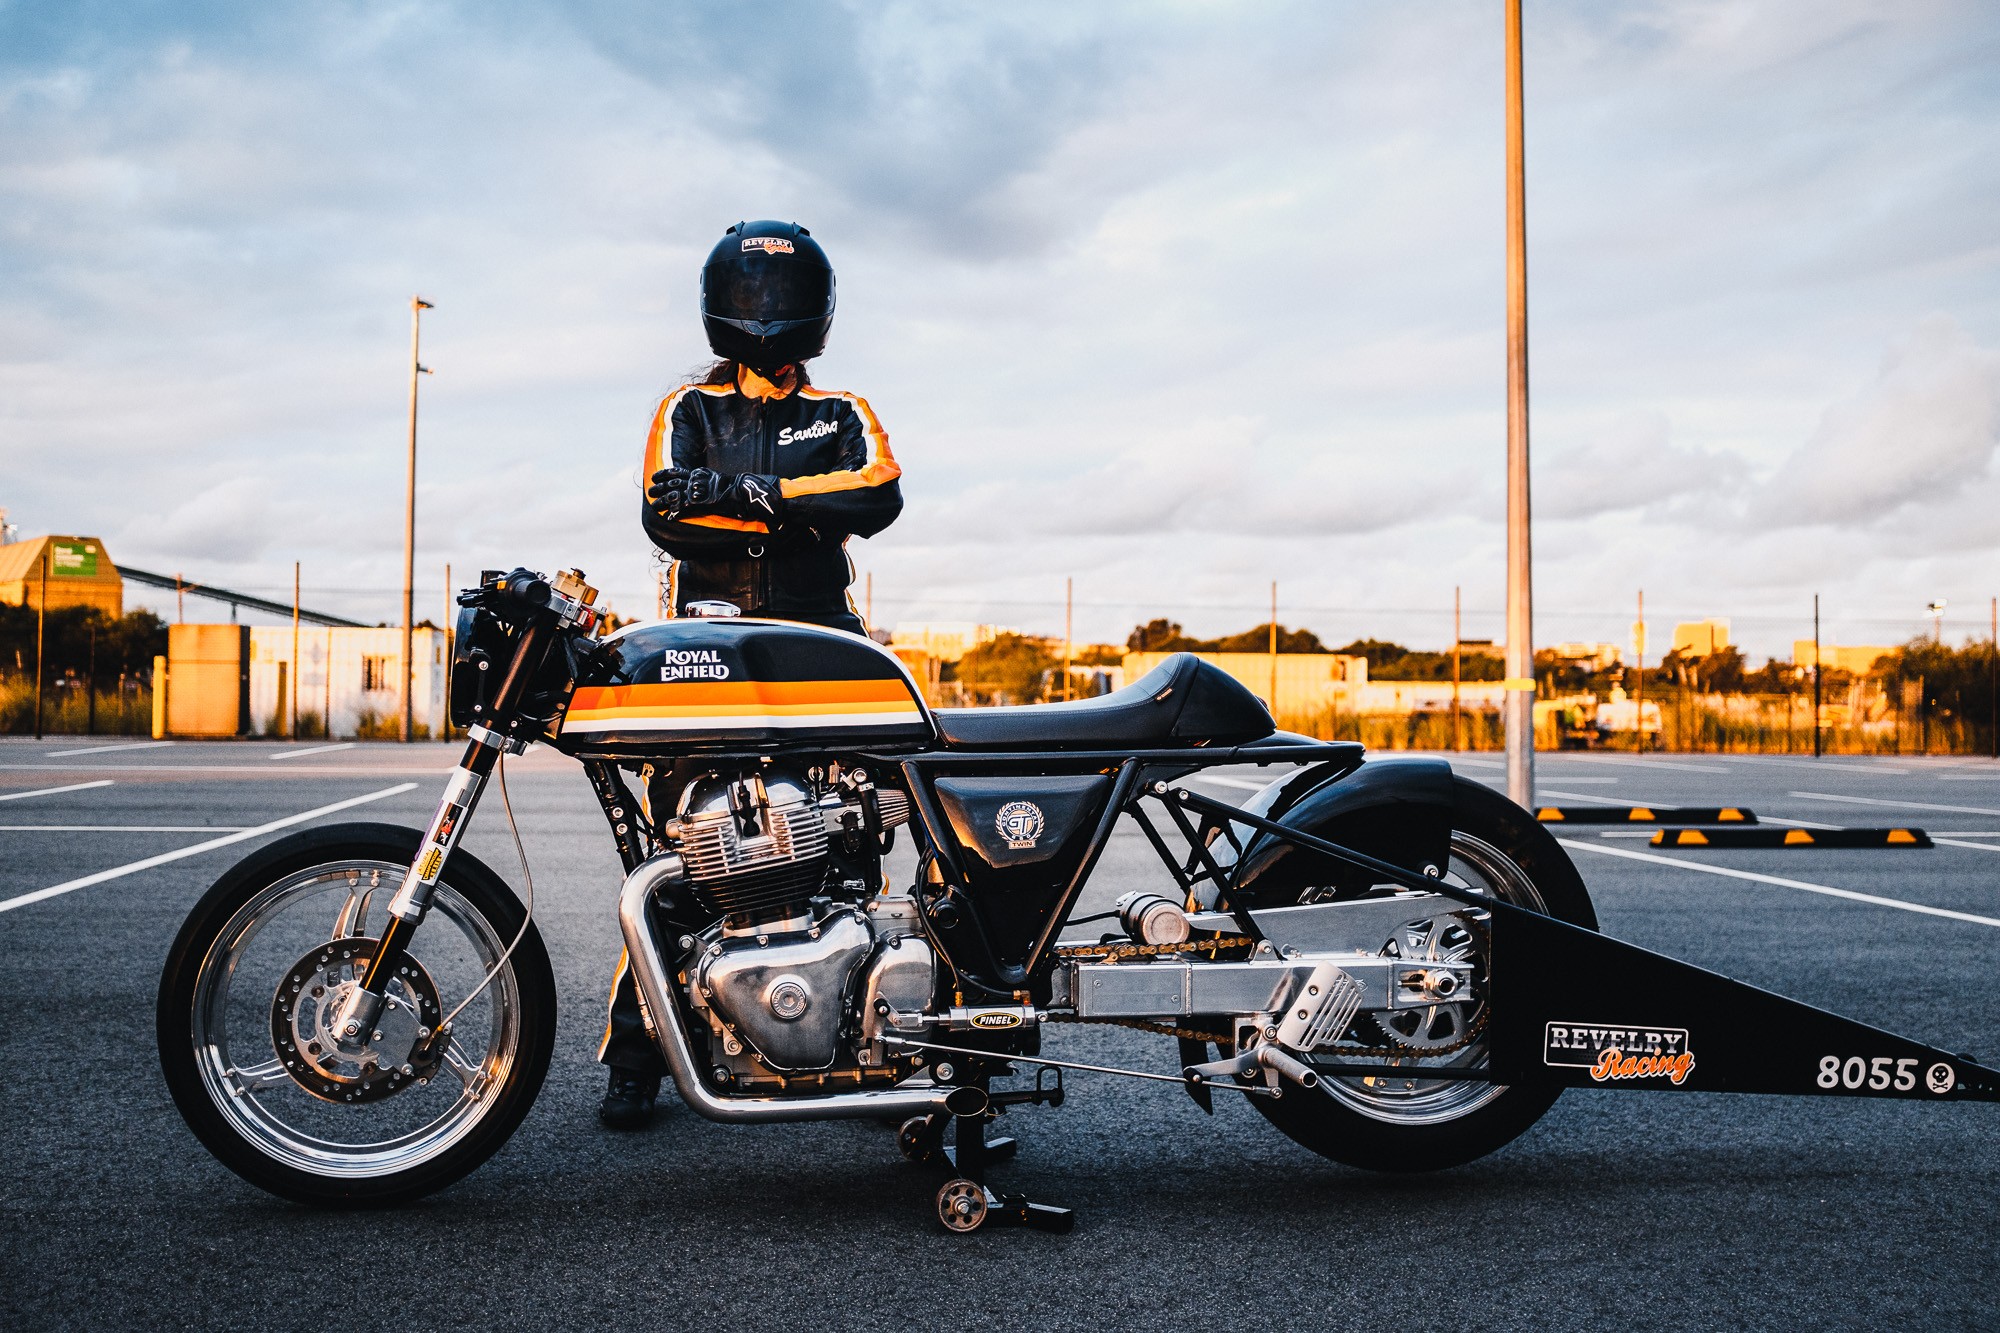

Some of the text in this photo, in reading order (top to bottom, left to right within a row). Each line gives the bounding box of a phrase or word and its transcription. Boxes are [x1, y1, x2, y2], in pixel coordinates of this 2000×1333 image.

[744, 239, 790, 247] REVELRY
[665, 649, 721, 665] ROYAL
[660, 665, 730, 682] ENFIELD
[1007, 814, 1033, 835] GT
[980, 1016, 1011, 1025] PINGEL
[1550, 1027, 1682, 1054] REVELRY
[1590, 1048, 1695, 1085] Racing
[1816, 1055, 1919, 1091] 8055
